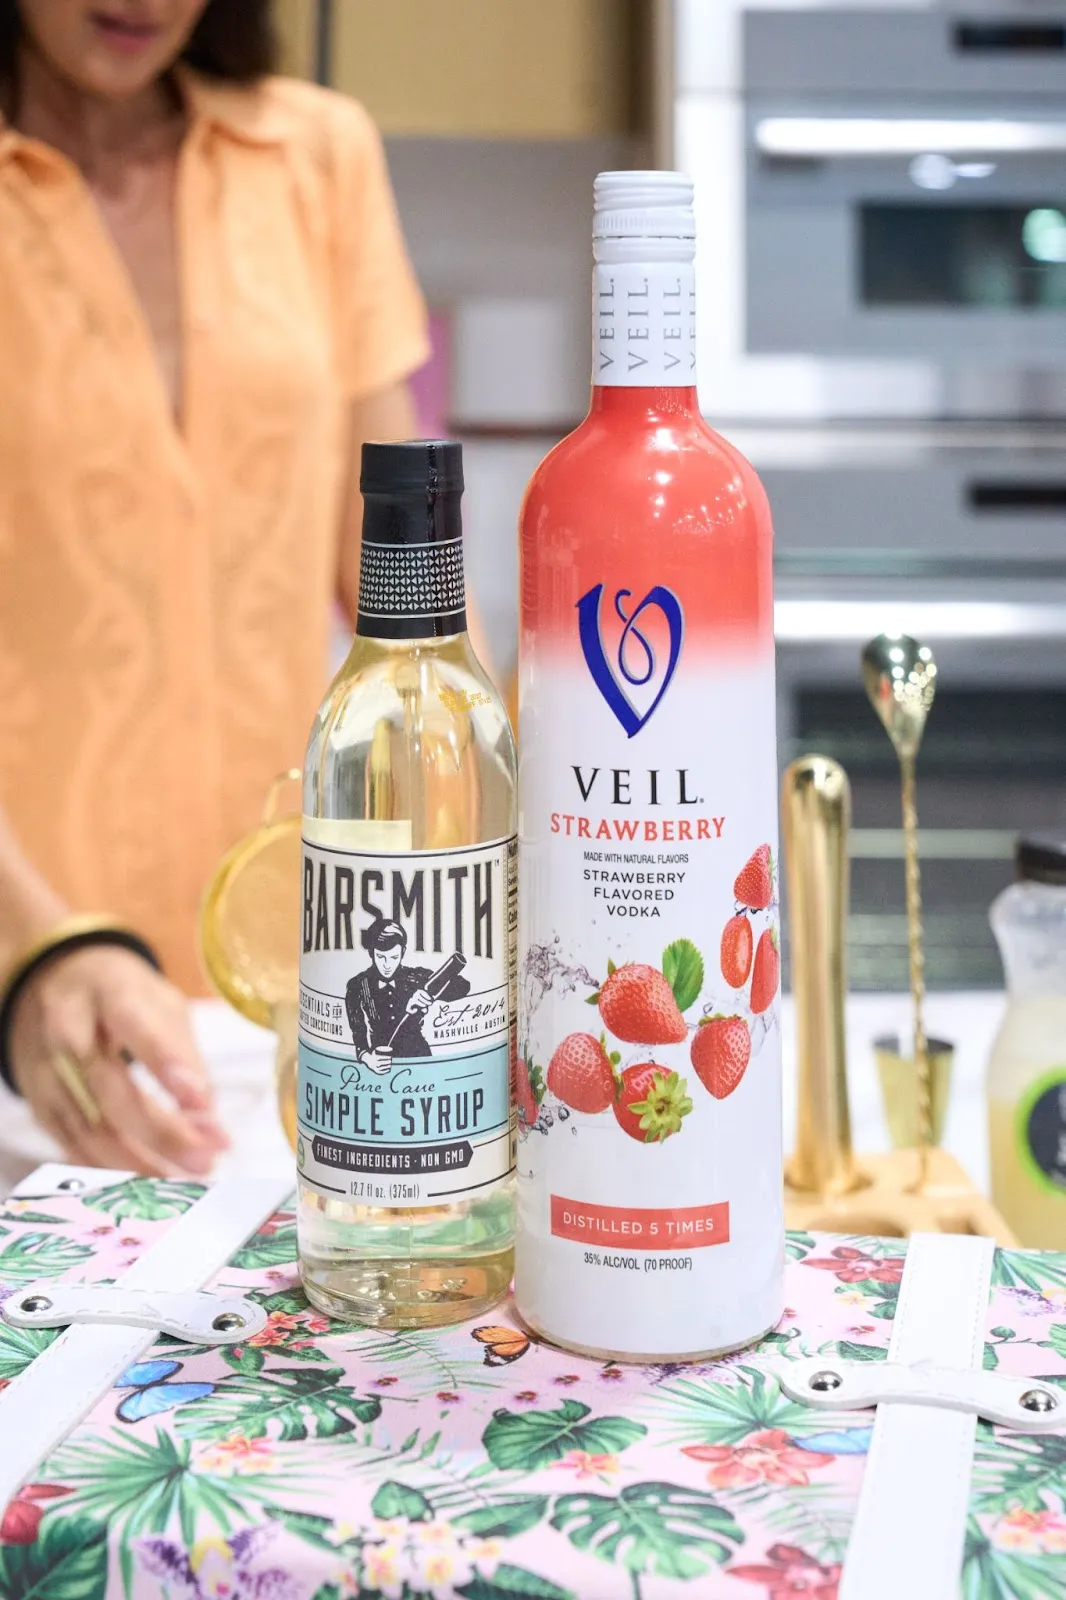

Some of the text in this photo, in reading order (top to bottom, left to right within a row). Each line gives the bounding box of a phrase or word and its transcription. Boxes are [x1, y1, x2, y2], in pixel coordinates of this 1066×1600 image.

[550, 812, 726, 842] STRAWBERRY
[583, 851, 689, 864] MADE WITH NATURAL FLAVORS
[583, 869, 686, 884] STRAWBERRY
[594, 886, 675, 901] FLAVORED
[606, 904, 661, 918] VODKA
[432, 997, 505, 1028] Est. 2014
[433, 1015, 505, 1039] NASHVILLE AUSTIN
[339, 1065, 382, 1093] Pure
[306, 1082, 484, 1137] SIMPLE SYRUP
[316, 1143, 343, 1163] FINEST
[346, 1151, 410, 1169] INGREDIENTS
[420, 1154, 440, 1168] NON
[445, 1149, 464, 1165] GMO
[350, 1181, 364, 1197] 12.7
[375, 1187, 386, 1198] oz.
[389, 1183, 420, 1199] (375ml)
[563, 1211, 714, 1236] DISTILLED 5 TIMES
[584, 1251, 693, 1272] 35% ALC/VOL (70 PROOF)
